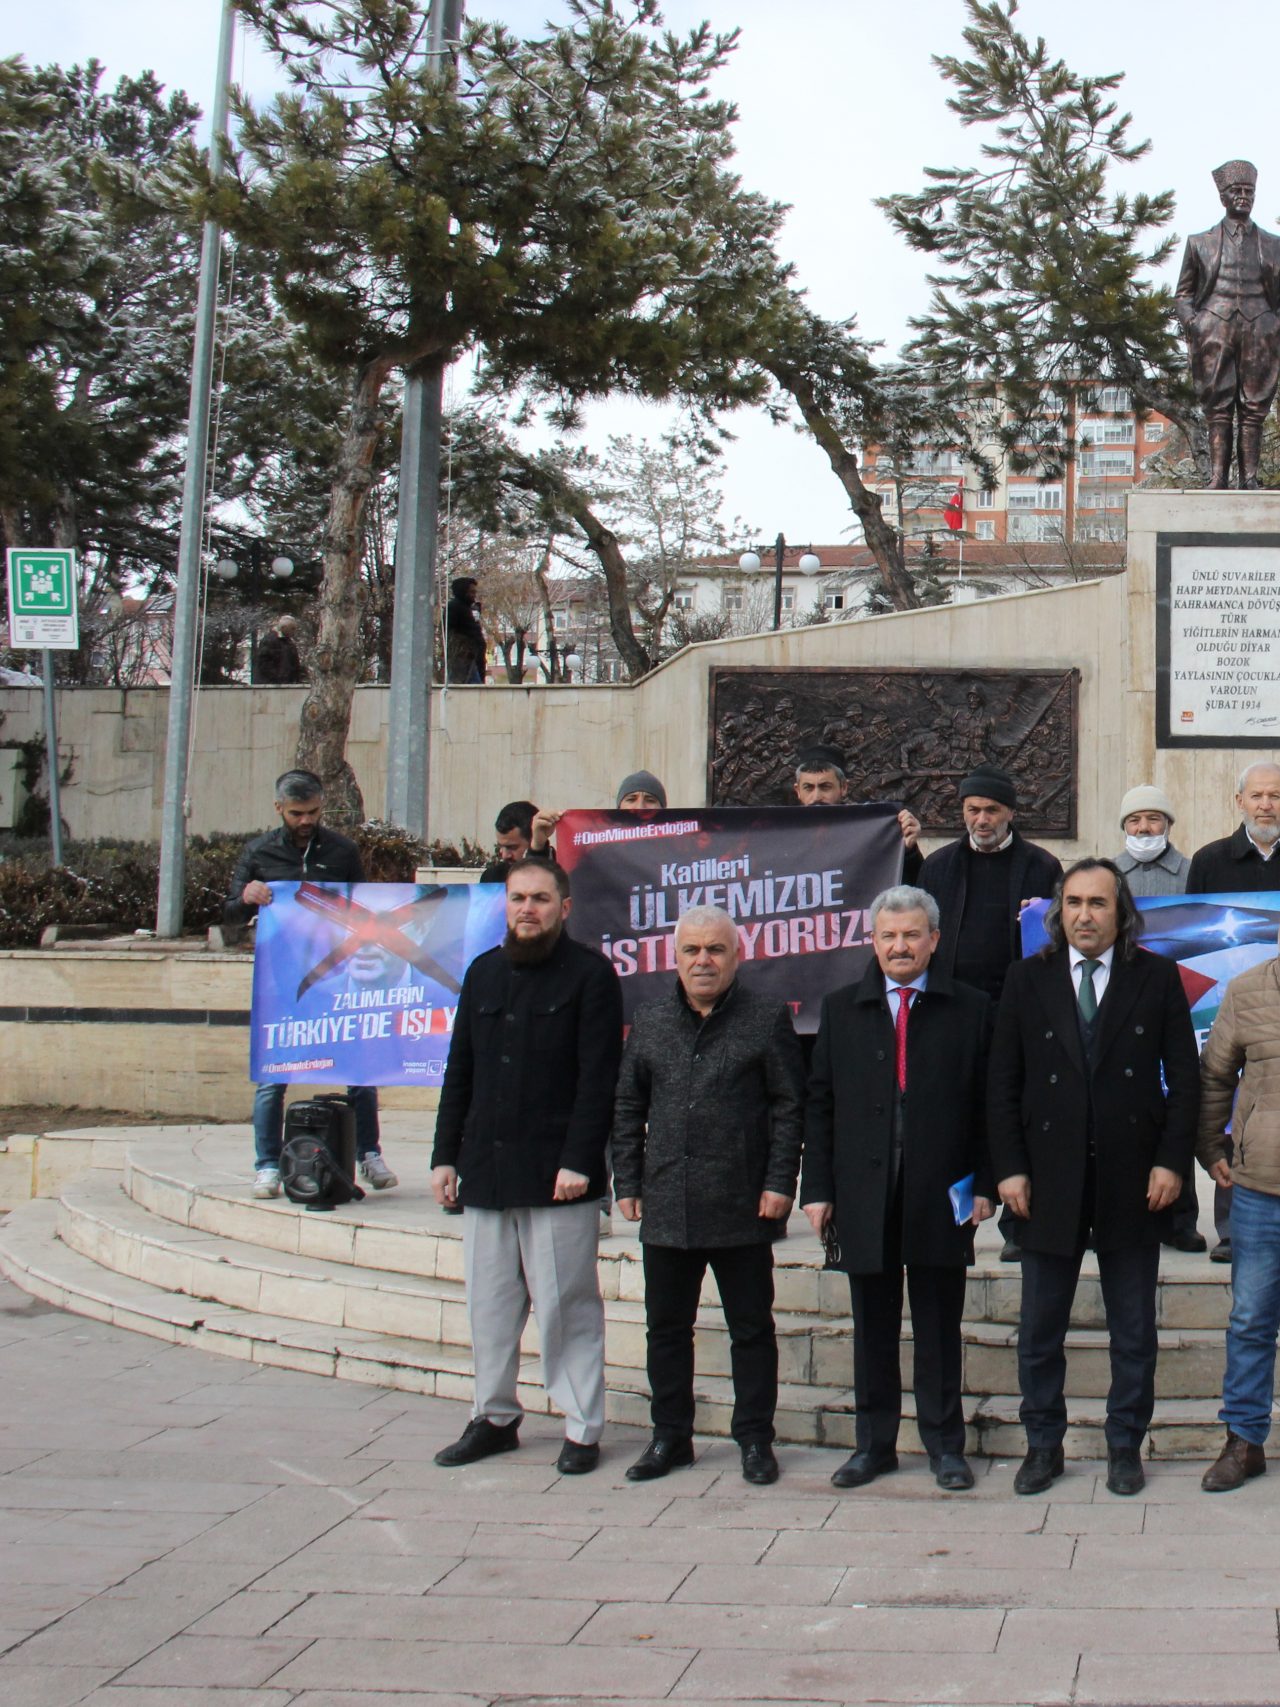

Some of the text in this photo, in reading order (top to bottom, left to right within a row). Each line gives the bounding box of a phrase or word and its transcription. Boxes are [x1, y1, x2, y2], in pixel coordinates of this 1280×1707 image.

[1192, 570, 1276, 581] ÜNLÜ SUVARİLER
[1176, 585, 1204, 595] HARP
[1174, 600, 1244, 610] KAHRAMANCA
[1220, 613, 1248, 624] TÜRK
[1183, 626, 1239, 638] YİĞİTLERİN
[1196, 641, 1271, 652] OLDUĞU DİYAR
[1216, 657, 1250, 667] BOZOK
[1174, 671, 1234, 681] YAYLASININ
[1210, 686, 1258, 695] VAROLUN
[1205, 700, 1261, 711] ŞUBAT 1934
[573, 821, 699, 846] #OneMinuteErdoğan
[661, 854, 750, 887] Katilleri
[629, 869, 844, 931] ÜLKEMİZDE
[332, 982, 425, 1011] ZALİMLERİN
[262, 1011, 393, 1050] TÜRKİYE'DE
[400, 1002, 433, 1042] İŞİ
